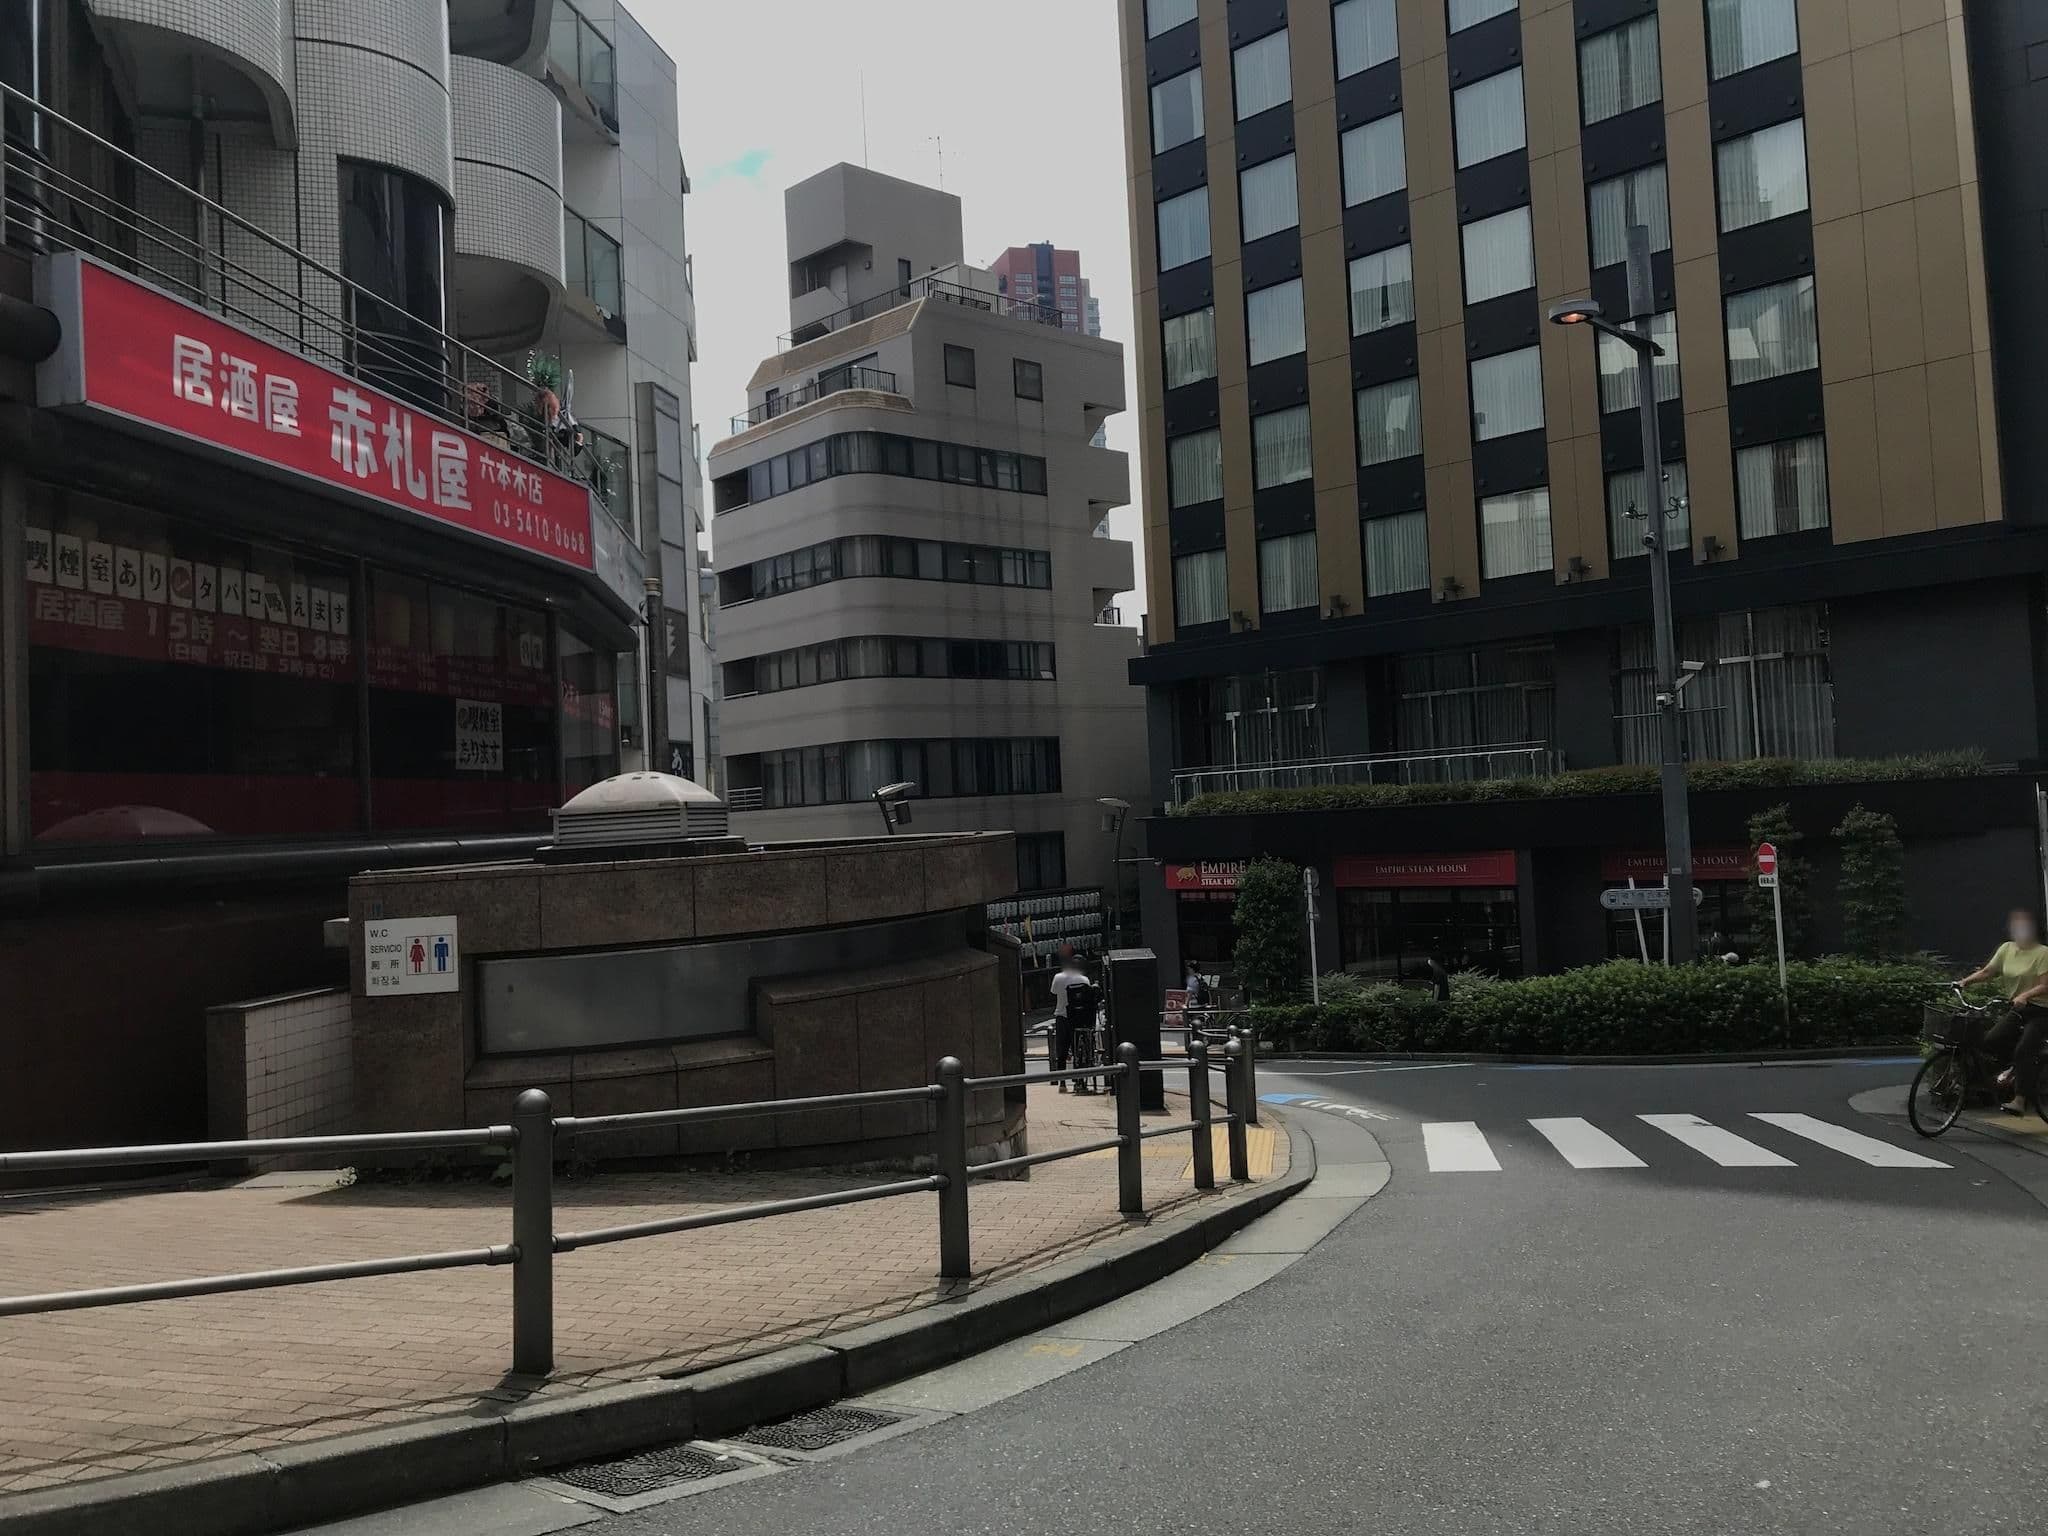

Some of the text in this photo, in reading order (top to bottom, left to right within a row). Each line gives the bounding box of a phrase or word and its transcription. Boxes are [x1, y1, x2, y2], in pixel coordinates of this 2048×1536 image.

[173, 333, 473, 512] 居酒屋 赤札屋
[479, 450, 544, 506] 六本木店
[35, 587, 126, 633] 居酒屋
[1201, 859, 1247, 874] EMPIRE
[1627, 857, 1665, 867] EMPIRE
[1702, 855, 1741, 865] HOUSE
[1374, 863, 1407, 874] EMPIRE
[1437, 863, 1468, 873] HOUSE
[1200, 877, 1223, 886] STEAK
[370, 944, 402, 954] SERVICIO
[372, 976, 399, 986] 화장실
